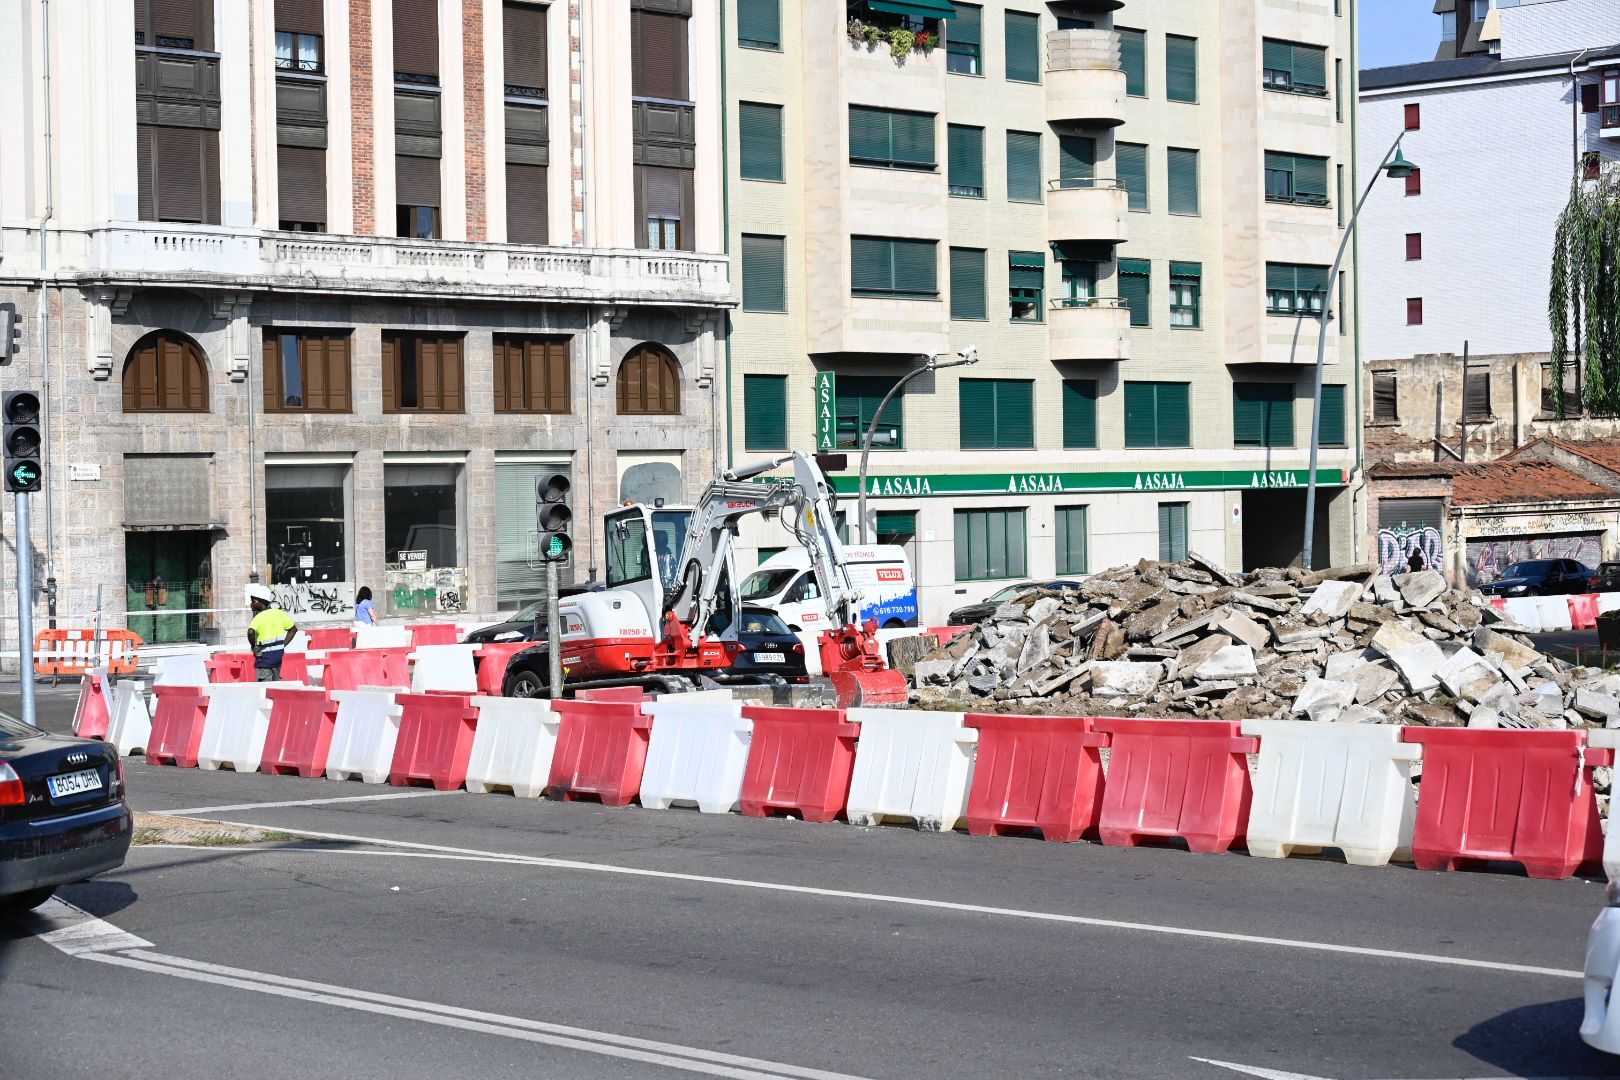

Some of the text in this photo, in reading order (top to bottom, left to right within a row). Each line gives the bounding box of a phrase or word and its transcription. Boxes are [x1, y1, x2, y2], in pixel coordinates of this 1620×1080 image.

[820, 374, 832, 447] ASAJA
[883, 477, 933, 495] ASAJA
[1019, 475, 1064, 492] ASAJA
[1144, 473, 1185, 490] ASAJA
[1260, 472, 1298, 487] ASAJA
[879, 569, 902, 579] VELUX
[56, 770, 100, 793] 8054 DHN
